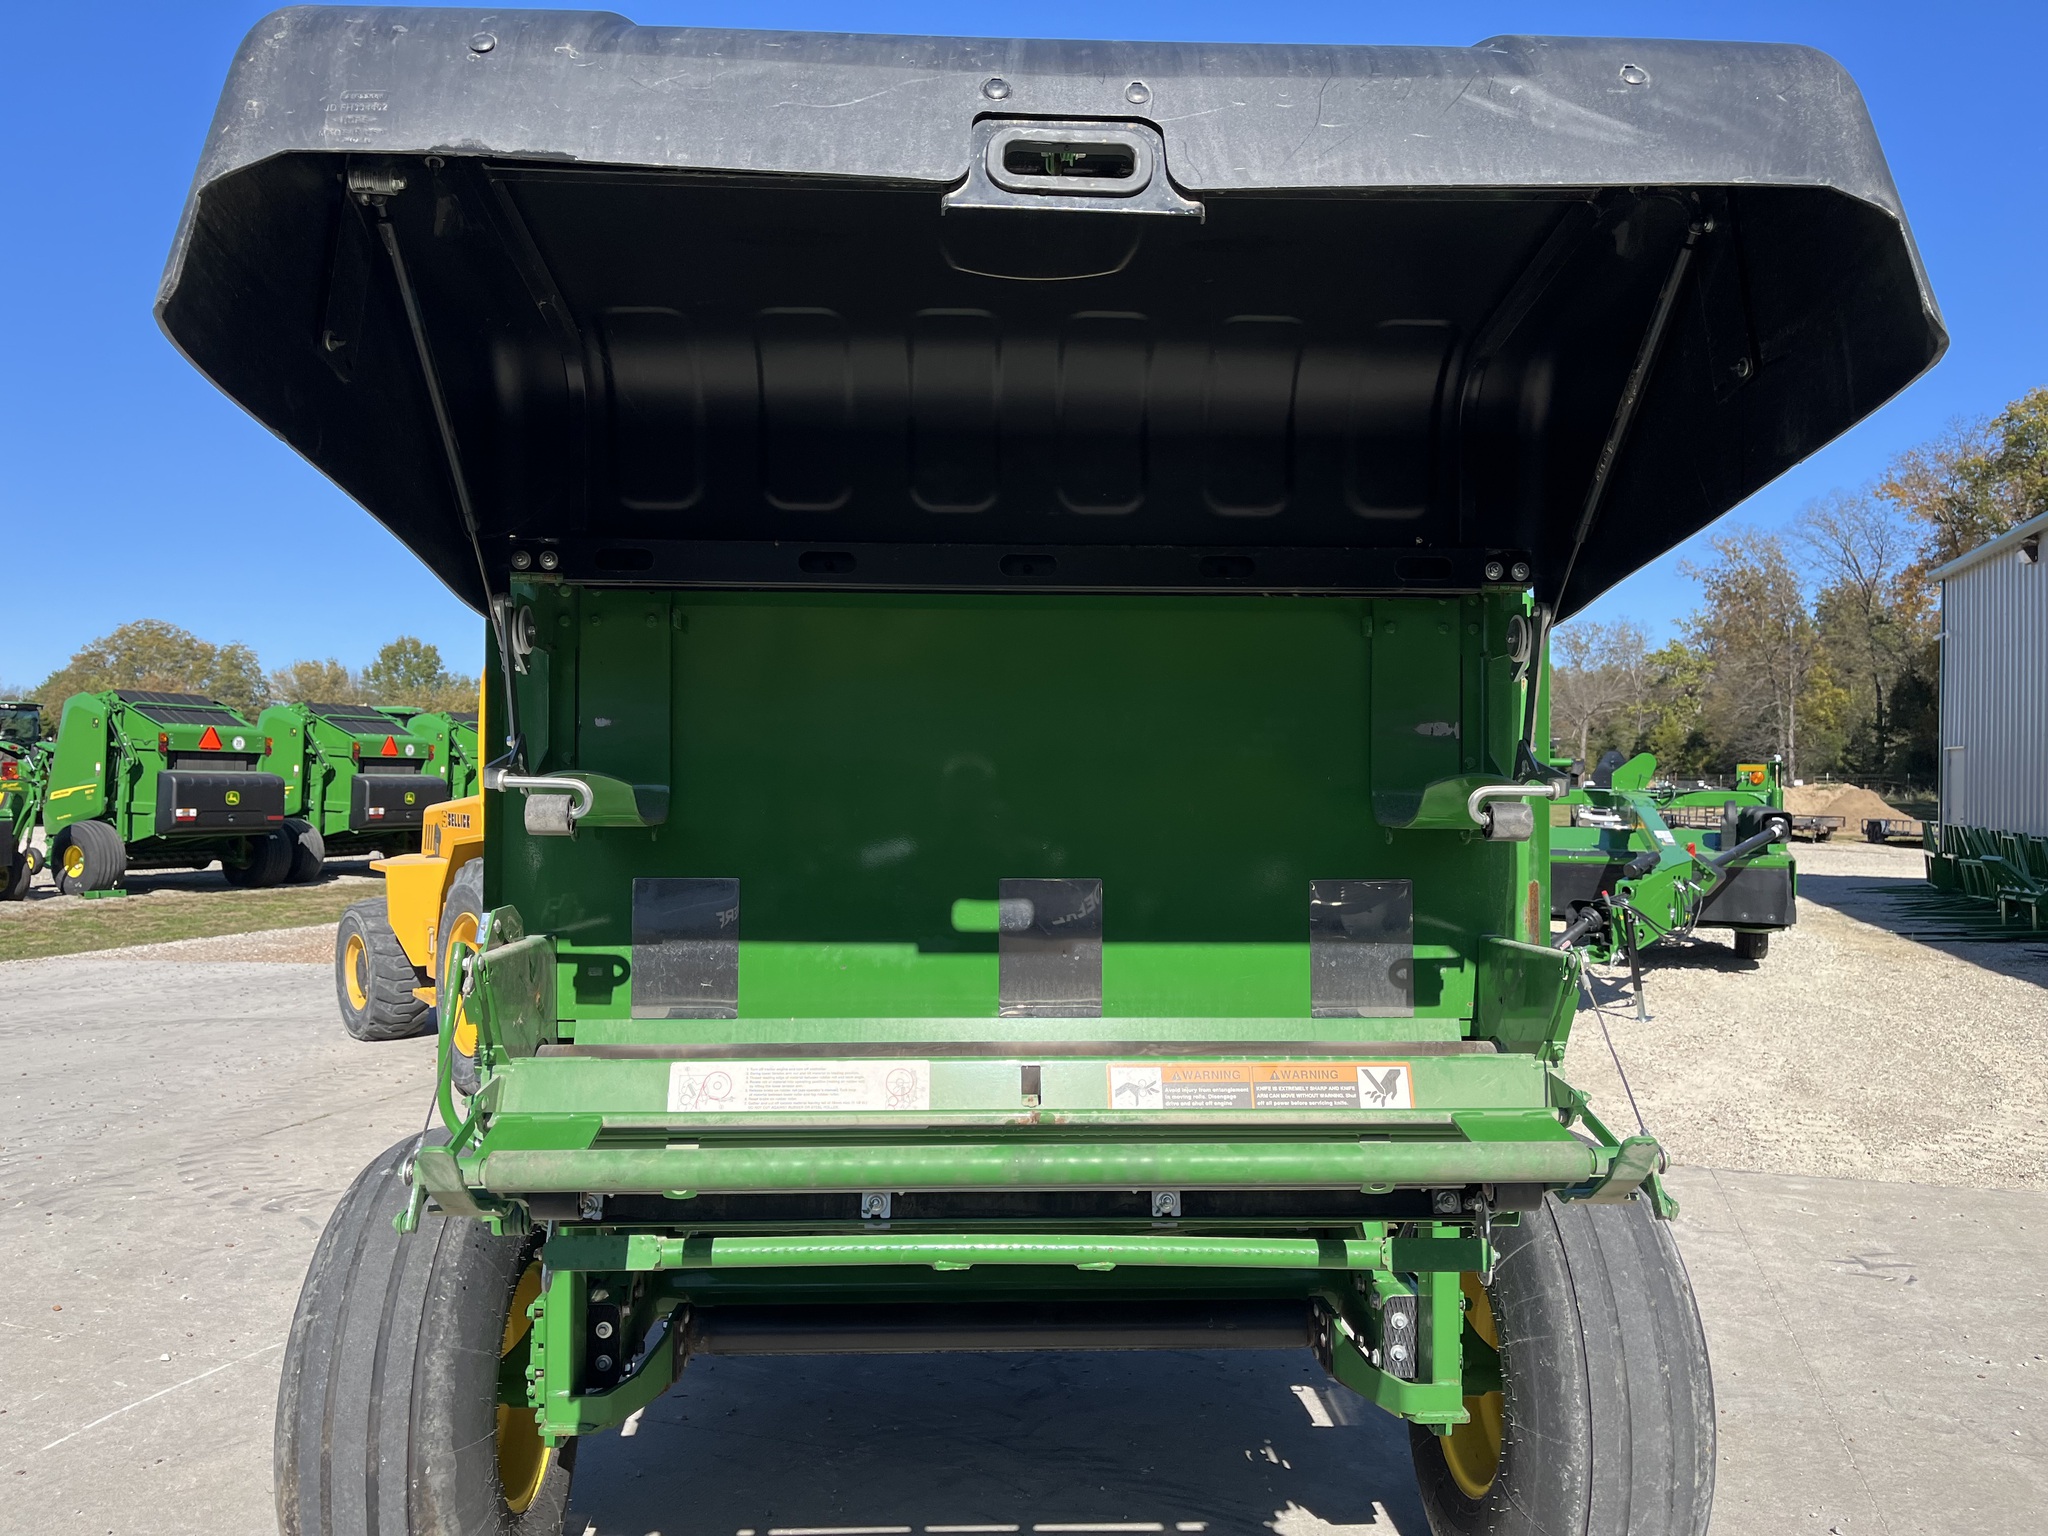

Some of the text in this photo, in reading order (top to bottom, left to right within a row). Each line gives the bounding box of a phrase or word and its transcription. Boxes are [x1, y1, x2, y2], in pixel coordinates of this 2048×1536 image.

[447, 812, 471, 829] SELLICK
[1181, 1069, 1241, 1080] WARNING
[1280, 1069, 1339, 1080] WARNING
